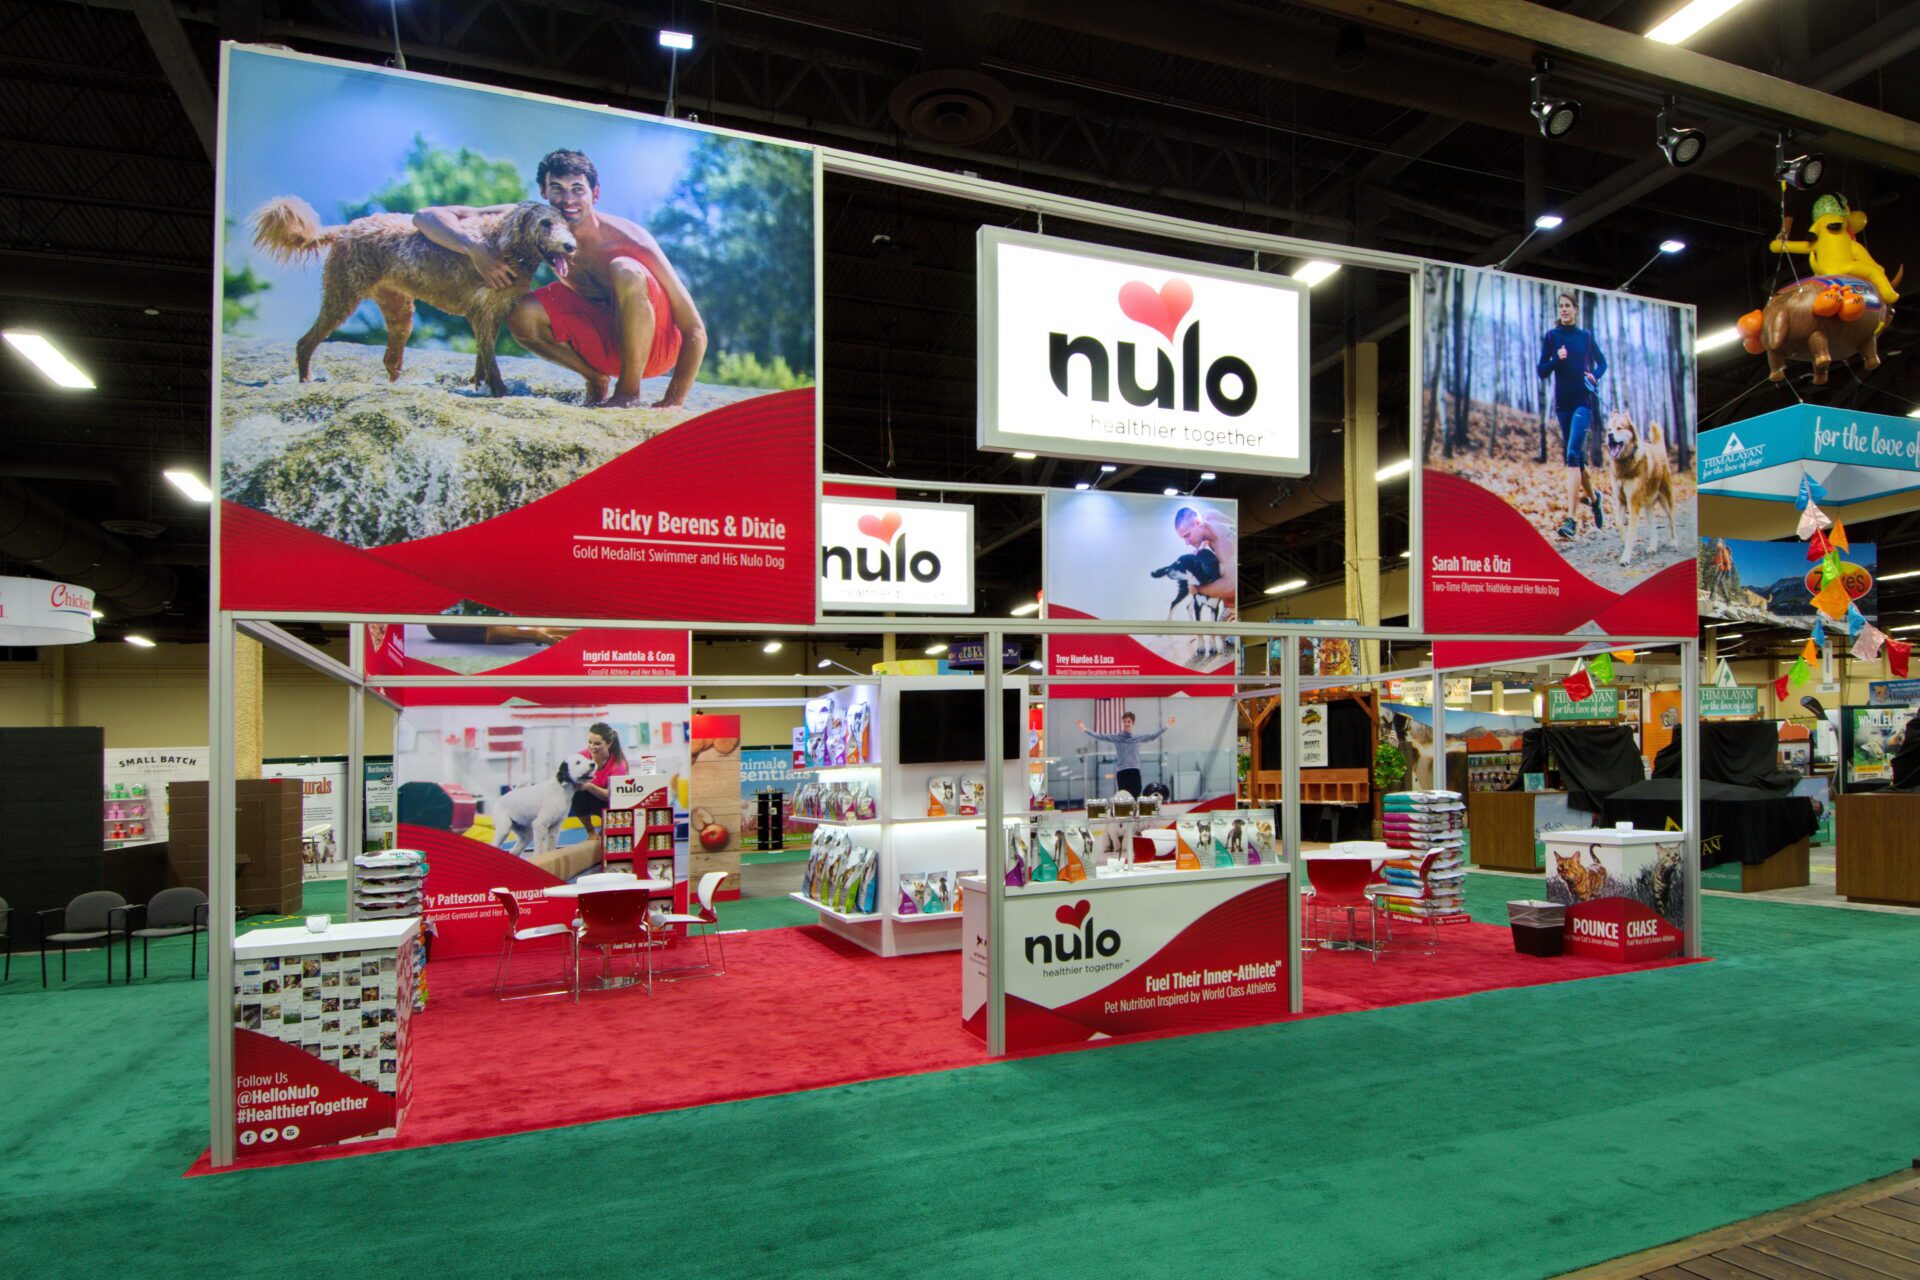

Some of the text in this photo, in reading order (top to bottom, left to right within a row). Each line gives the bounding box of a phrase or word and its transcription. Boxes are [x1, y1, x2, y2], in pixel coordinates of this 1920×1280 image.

[1049, 319, 1258, 418] nulo
[1091, 414, 1264, 447] healthier together
[1814, 416, 1840, 455] for
[1842, 422, 1868, 453] the
[1872, 426, 1904, 456] love
[1704, 446, 1765, 468] HIMALAYAN
[1703, 468, 1713, 480] for
[1724, 464, 1738, 472] love
[602, 508, 785, 540] Ricky Berens & Dixie
[573, 544, 785, 570] Gold Medalist Swimmer and His Nulo Dog
[822, 532, 941, 583] nulo
[1432, 556, 1459, 571] Sarah
[1461, 556, 1482, 572] True
[1483, 557, 1491, 573] &
[1432, 581, 1559, 596] Two-Time Olympic Triathlete and Her Nulo Dog
[582, 651, 675, 662] Ingrid Kantola & Cora
[1056, 654, 1115, 665] Trey Hardee & Luca
[588, 668, 609, 676] CrossFit
[610, 668, 628, 676] Athlete
[1702, 690, 1753, 700] HIMALAYAN
[1552, 702, 1615, 718] for the love of dogs
[1710, 700, 1719, 710] the
[1720, 699, 1734, 709] love
[118, 755, 197, 767] SMALL BATCH
[616, 783, 644, 794] nulo
[437, 892, 486, 905] Patterson
[488, 891, 496, 901] &
[452, 911, 479, 920] Gymnast
[479, 909, 491, 918] and
[492, 908, 503, 916] Her
[519, 906, 532, 916] Dog
[1573, 917, 1619, 940] POUNCE
[1627, 919, 1657, 938] CHASE
[1025, 916, 1121, 965] nulo
[1042, 965, 1082, 978] healthier
[1146, 972, 1170, 993] Fuel
[1172, 971, 1201, 990] Their
[1104, 981, 1277, 1014] Pet Nutrition Inspired by World Class Athletes
[237, 1072, 288, 1088] Follow Us
[237, 1083, 319, 1108] @HelloNulo
[237, 1096, 368, 1124] #HealthierTogether
